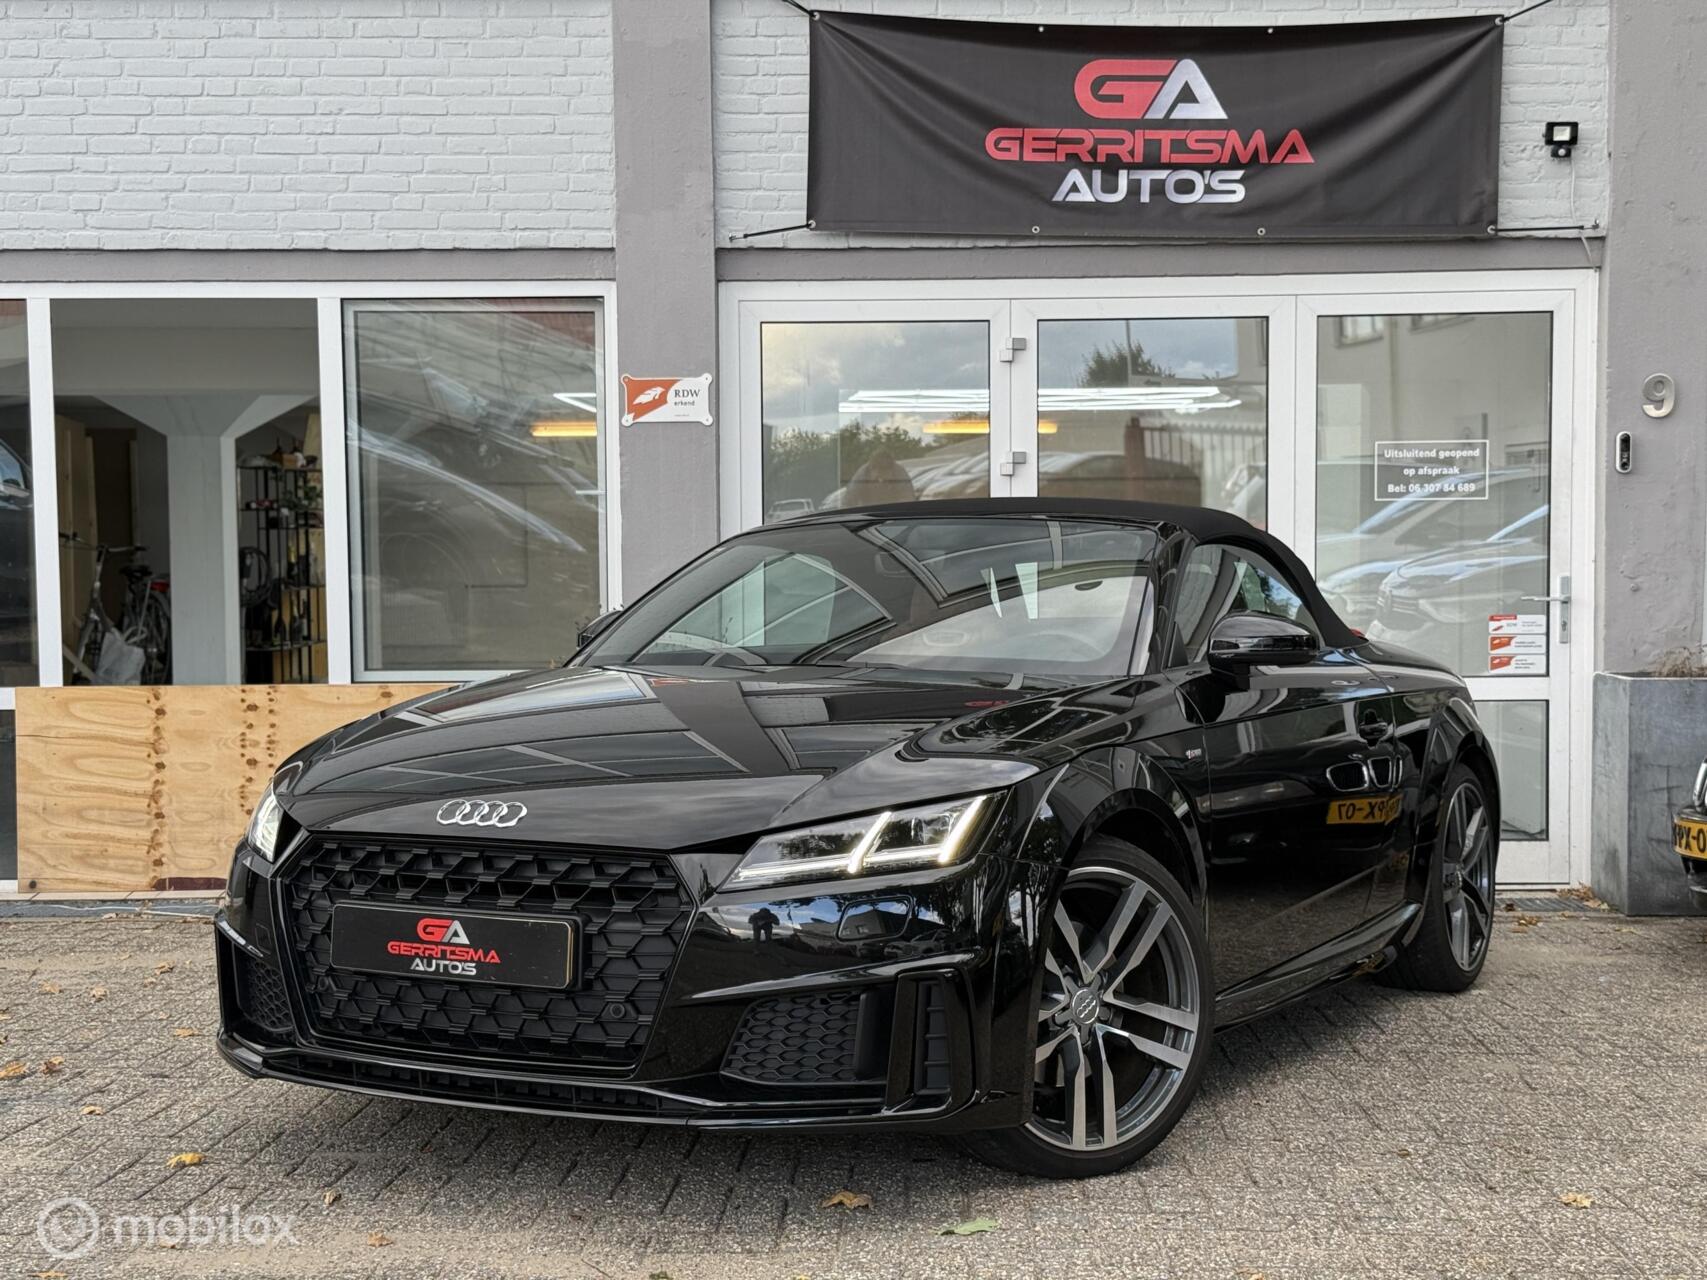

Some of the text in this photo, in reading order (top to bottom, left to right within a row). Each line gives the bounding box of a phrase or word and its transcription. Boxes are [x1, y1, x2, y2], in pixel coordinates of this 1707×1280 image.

[1074, 58, 1229, 119] GA
[985, 127, 1315, 164] GERRITSMA
[1051, 168, 1246, 204] AUTO'S
[674, 389, 701, 398] RDW
[1642, 373, 1675, 418] 9
[1384, 448, 1480, 459] Uitsluitend geopend
[1403, 466, 1460, 477] op afspraak
[1387, 484, 1406, 493] Bel:
[1423, 483, 1440, 492] 307
[417, 918, 470, 944] GA
[387, 941, 501, 963] GERRITSMA
[410, 958, 477, 976] AUTO'S
